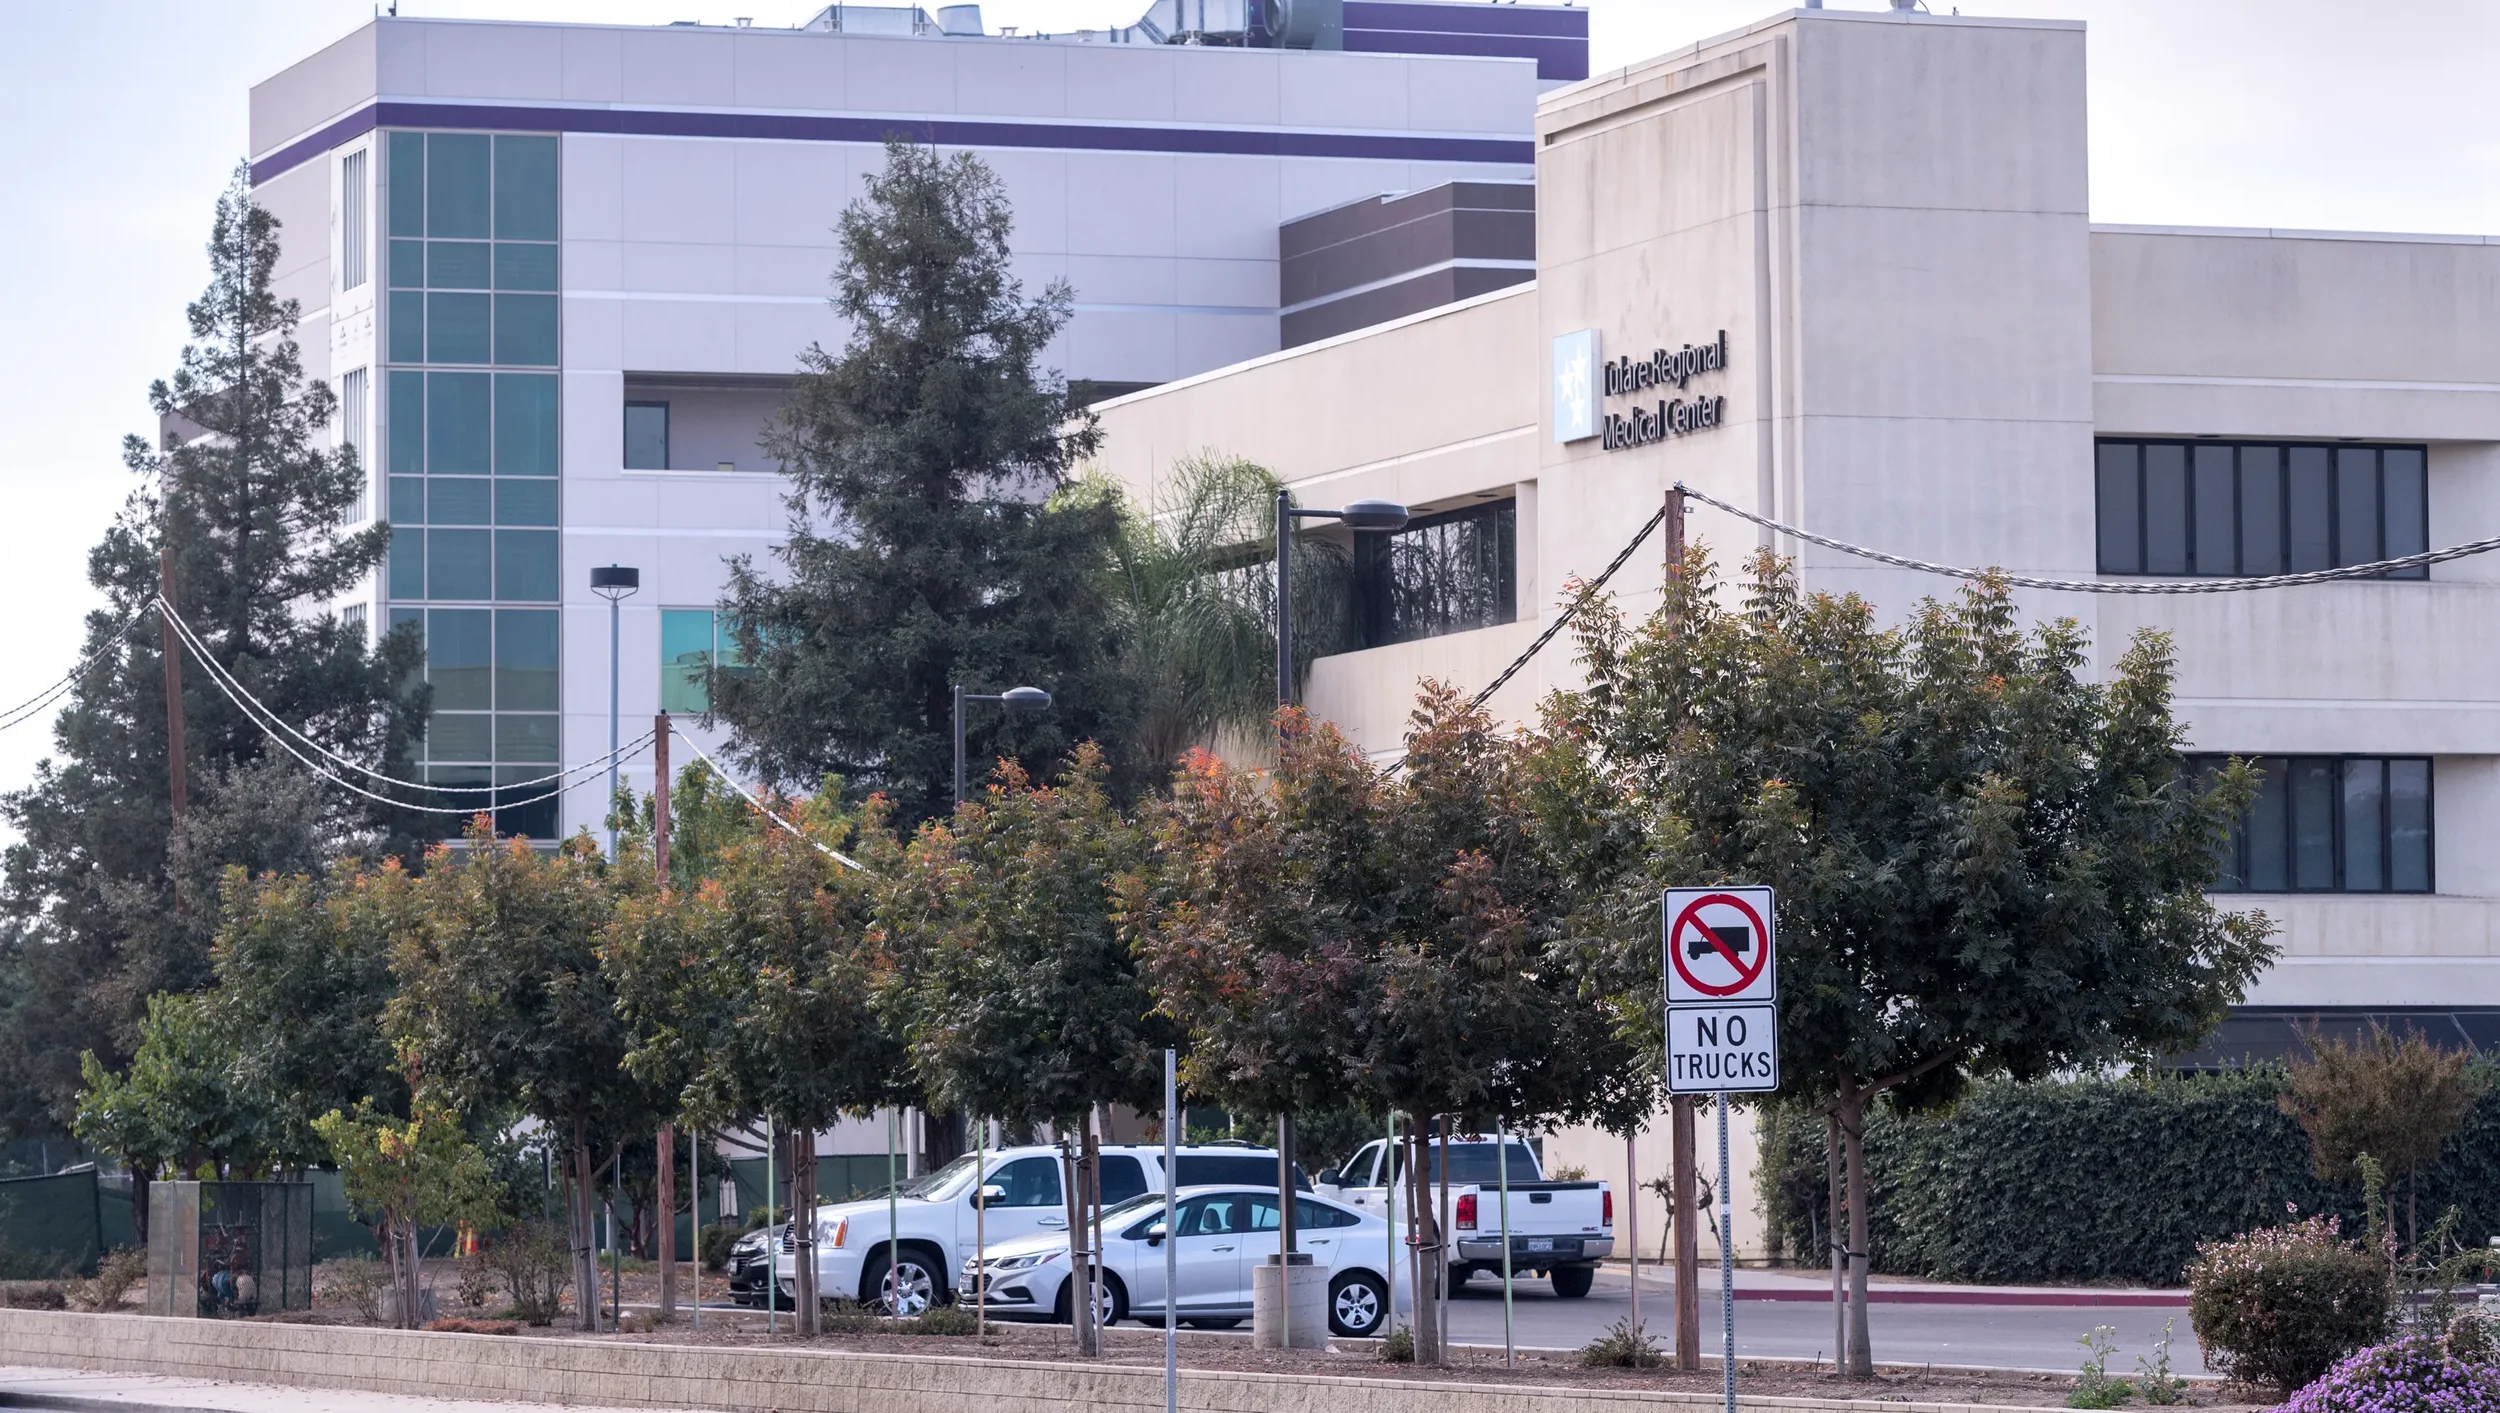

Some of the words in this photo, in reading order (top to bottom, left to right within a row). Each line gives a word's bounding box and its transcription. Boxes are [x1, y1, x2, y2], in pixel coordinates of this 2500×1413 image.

[1604, 355, 1653, 397] Tulare
[1651, 329, 1726, 389] Regional
[1602, 400, 1666, 451] Medical
[1664, 395, 1724, 435] Center
[1697, 1015, 1747, 1048] NO
[1673, 1051, 1771, 1079] TRUCKS
